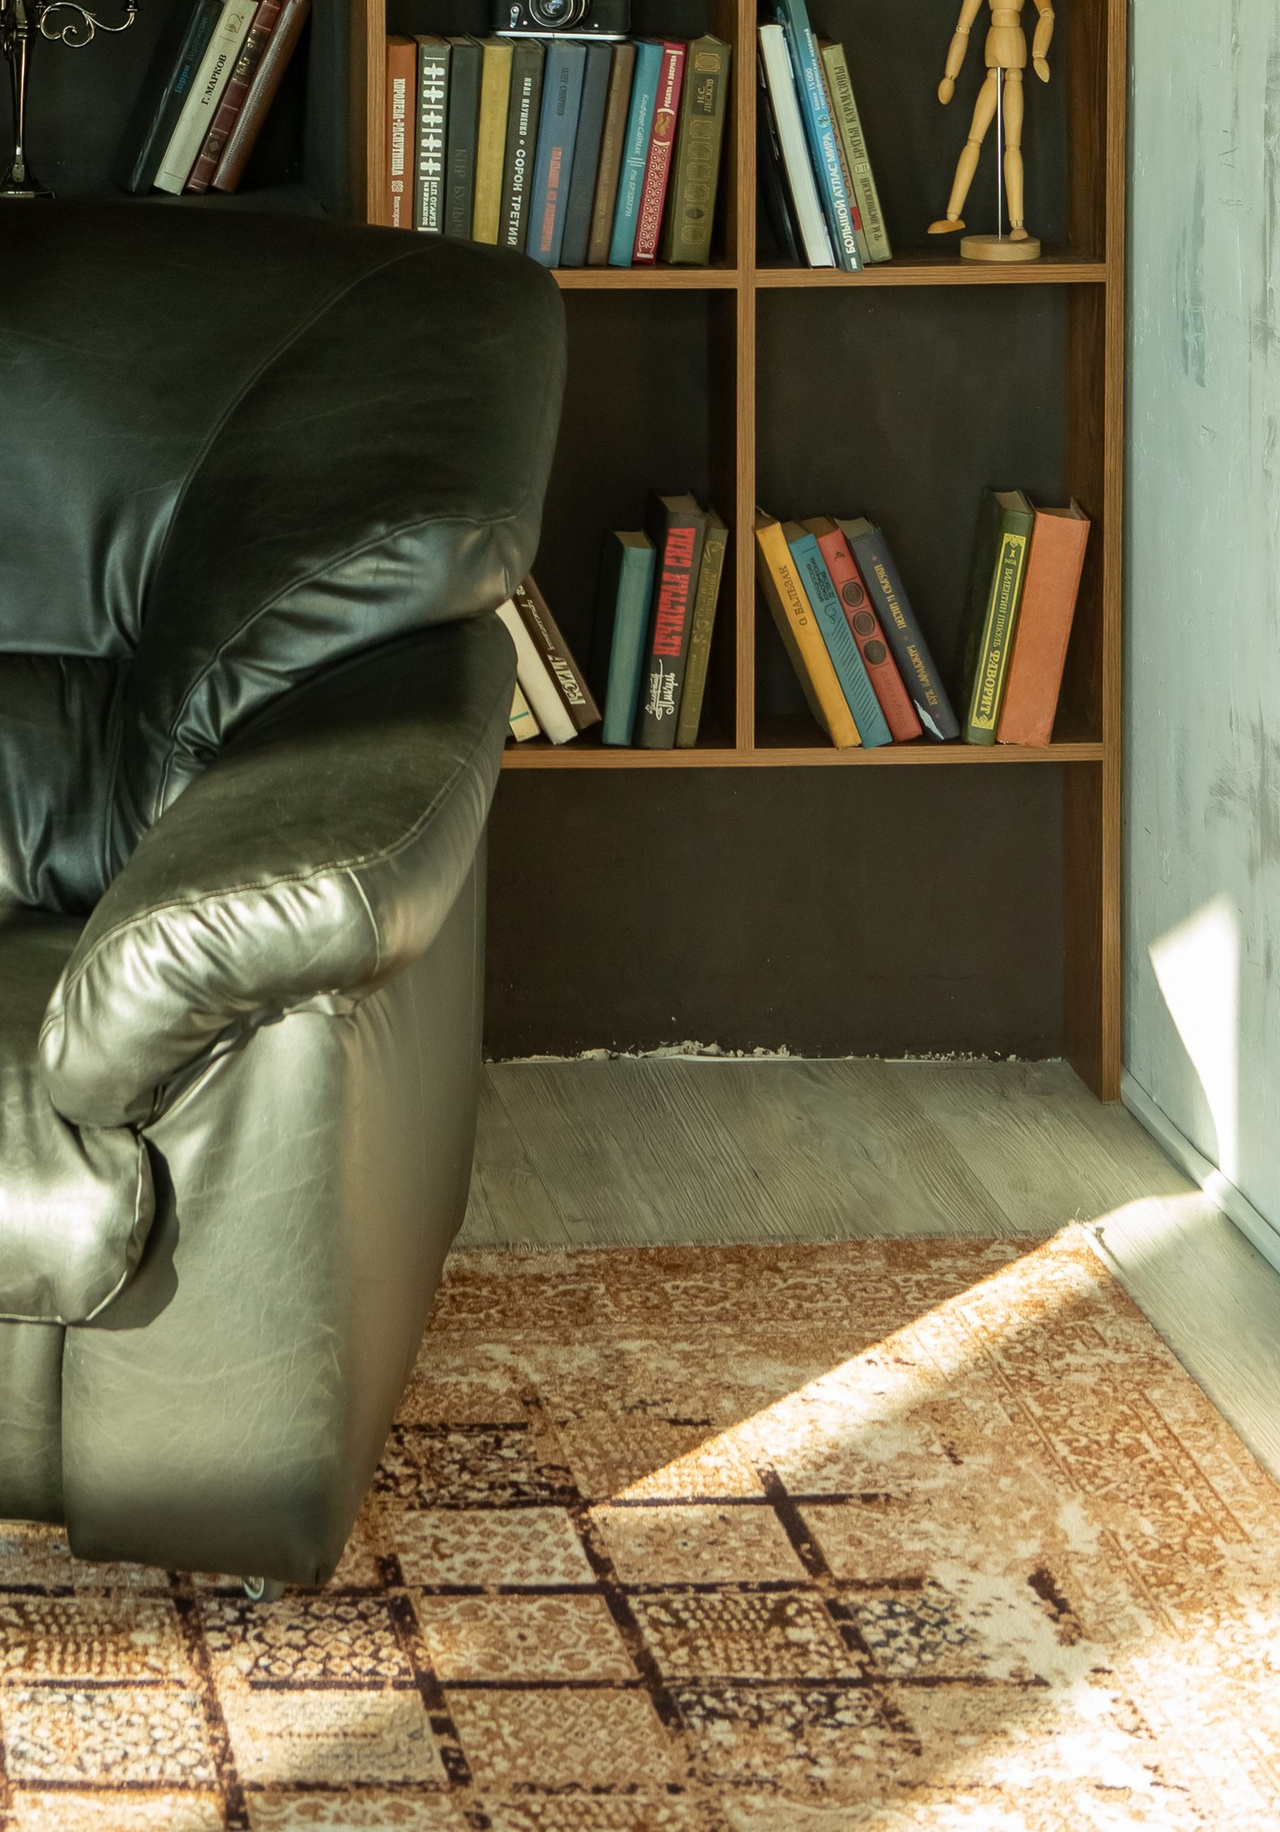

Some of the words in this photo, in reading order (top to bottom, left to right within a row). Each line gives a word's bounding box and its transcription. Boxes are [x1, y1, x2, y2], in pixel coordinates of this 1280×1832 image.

[802, 27, 815, 57] названий
[173, 62, 192, 94] Гарри
[203, 52, 228, 96] МАРКОВ
[522, 77, 532, 96] ИВАН
[560, 66, 570, 84] ОЛЕГ
[809, 57, 827, 108] географических
[201, 94, 211, 105] Г.
[555, 84, 567, 116] СМИРНОВ
[702, 77, 715, 112] ЛЕСКОВ
[518, 98, 530, 136] НАУМЕНКО
[453, 148, 467, 178] КИР
[820, 131, 836, 162] МИРА
[512, 149, 526, 191] СОРОК
[827, 162, 844, 199] АТЛАС
[420, 181, 431, 226] ИЗБРАННОЕ
[507, 194, 522, 245] ТРЕТИЙ
[833, 198, 855, 254] БОЛЬШОЙ
[663, 524, 695, 567] СИЛА
[996, 567, 1013, 613] ВАЛЕНТИН
[652, 570, 690, 657] НЕЧИСТАЯ
[991, 614, 1005, 648] ПИКУЛЬ
[653, 670, 683, 716] Пикуль
[977, 649, 1001, 714] ФАВОРИТ
